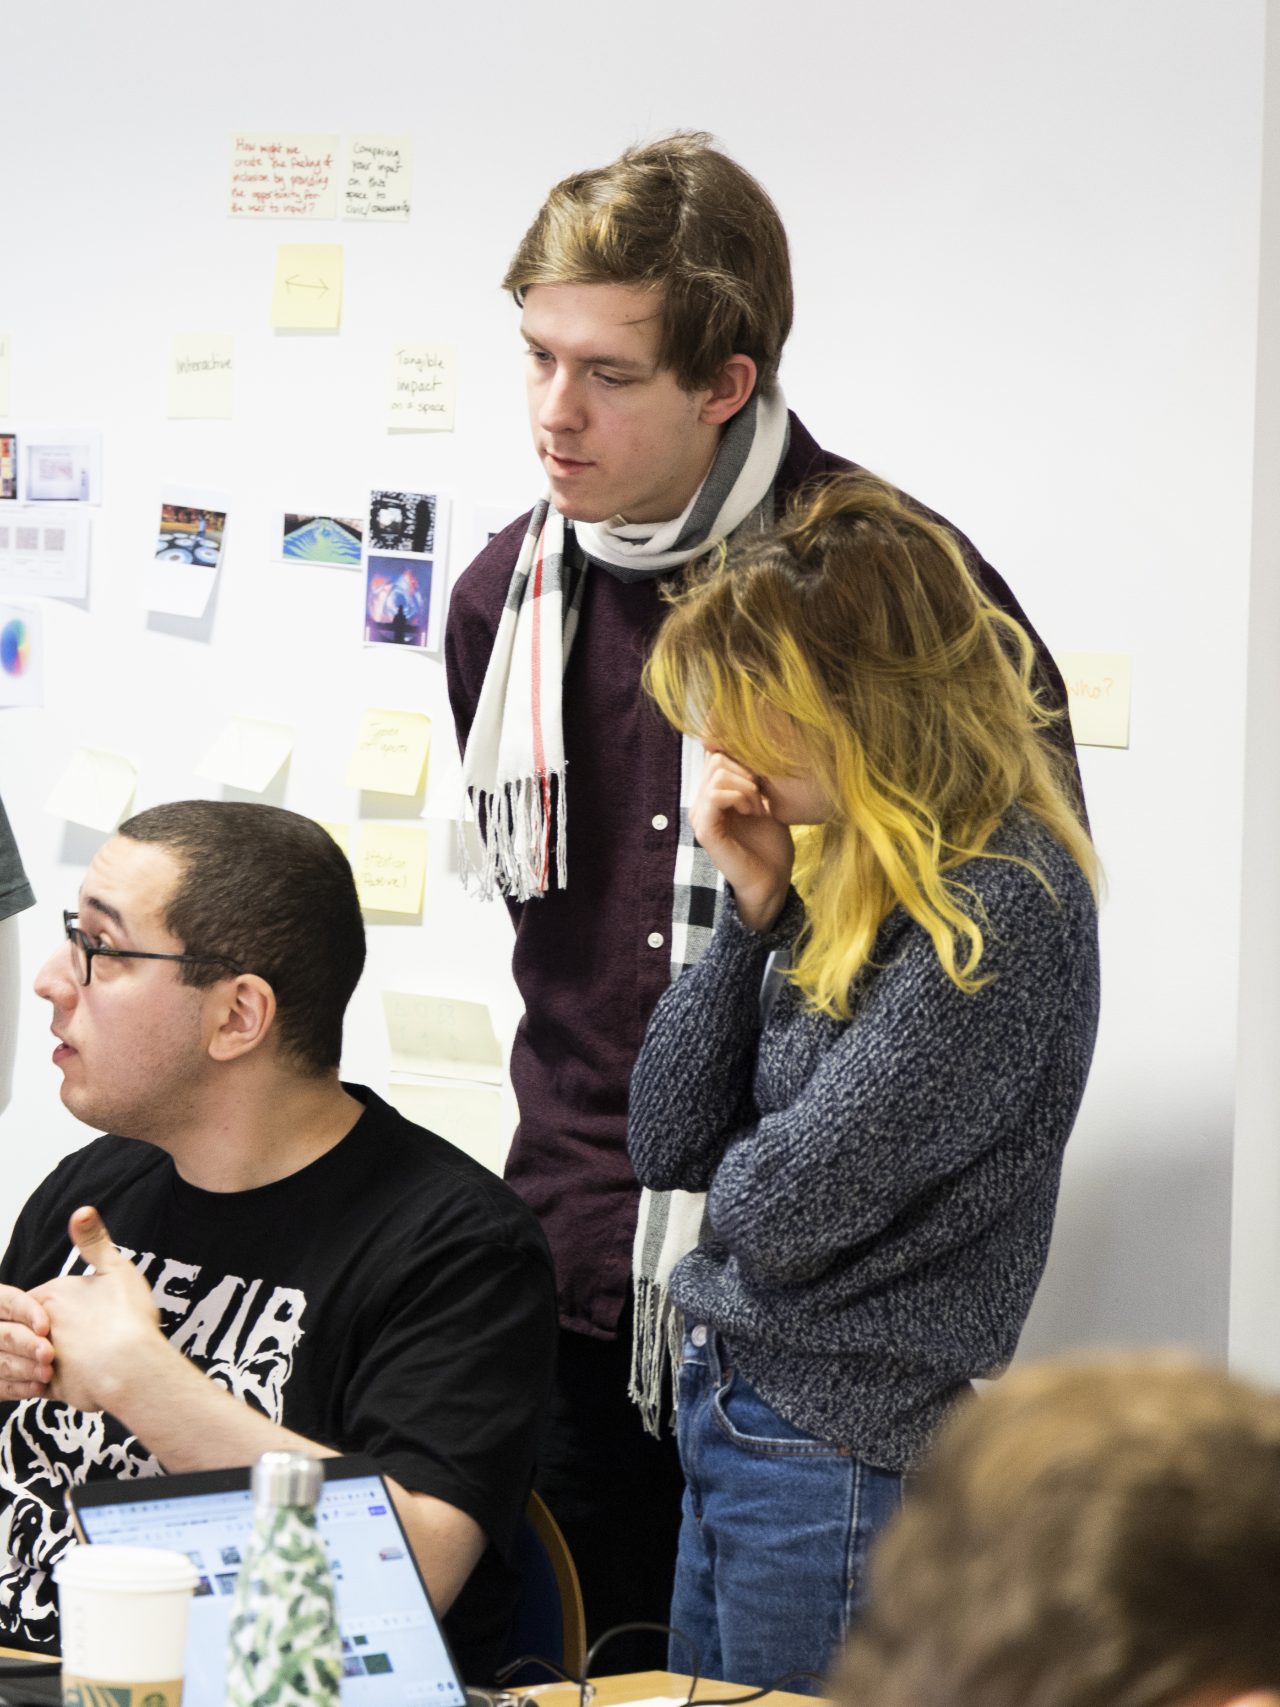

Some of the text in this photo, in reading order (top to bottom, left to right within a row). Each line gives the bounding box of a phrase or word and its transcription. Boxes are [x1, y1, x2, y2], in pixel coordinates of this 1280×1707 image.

[236, 138, 255, 151] How
[235, 156, 262, 167] create
[274, 173, 285, 191] by
[395, 349, 444, 373] Tangible
[396, 375, 442, 397] impact
[417, 403, 446, 415] space
